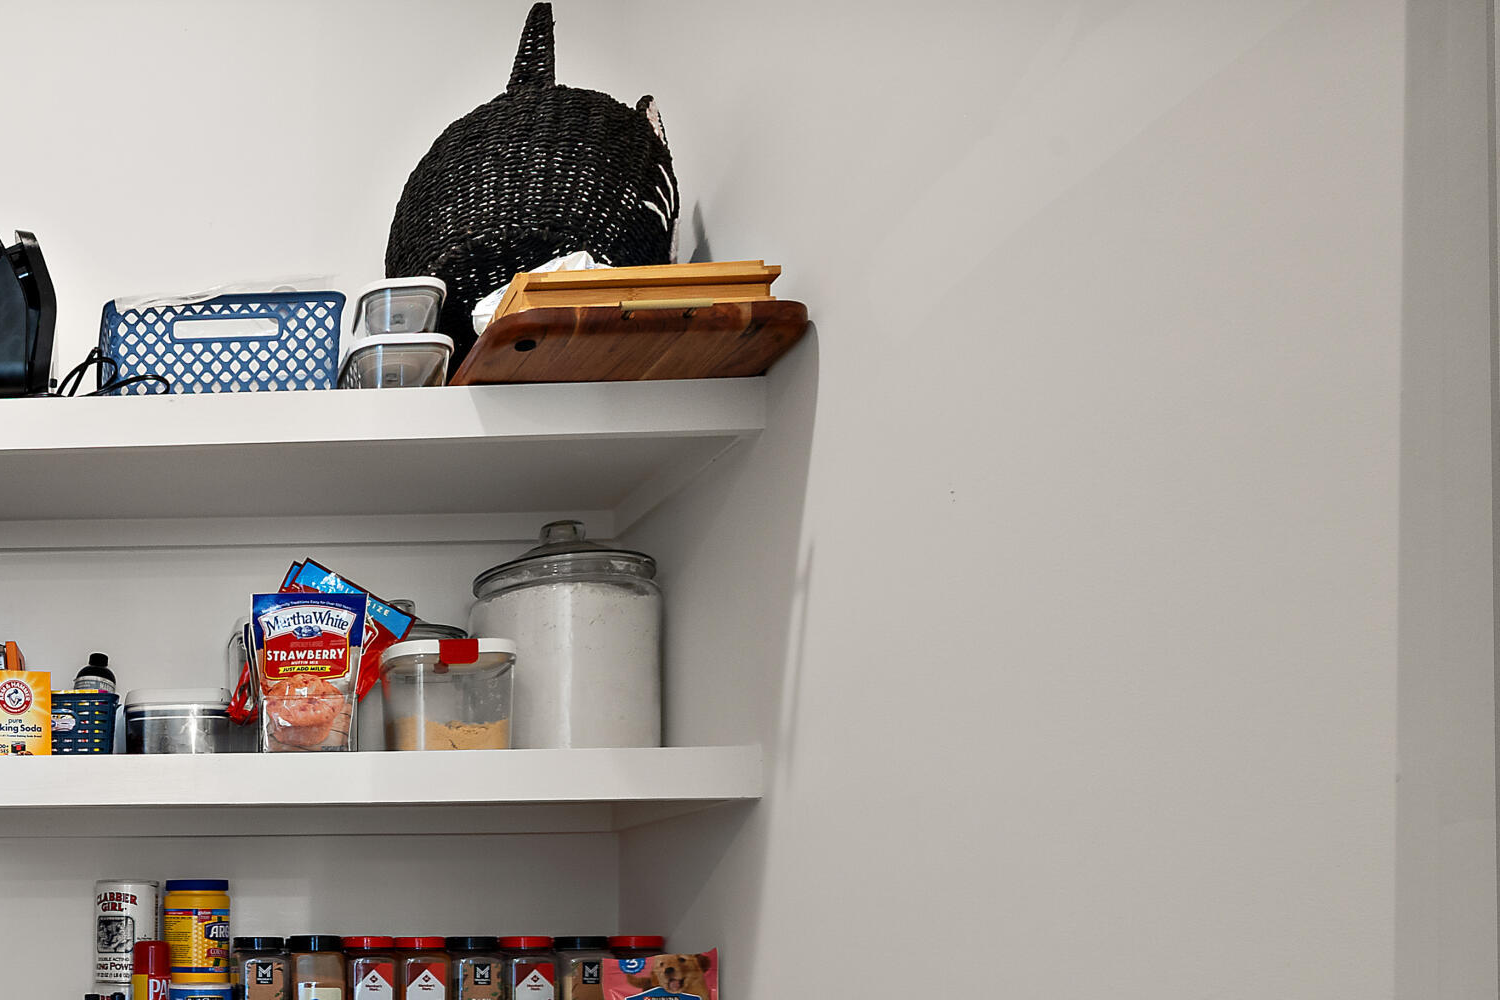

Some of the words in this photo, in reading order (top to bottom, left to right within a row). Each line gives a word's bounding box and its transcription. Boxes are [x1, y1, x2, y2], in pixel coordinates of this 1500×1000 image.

[265, 612, 312, 636] Martha
[312, 610, 349, 631] White
[267, 648, 345, 661] STRAWBERRY
[20, 724, 42, 732] Soda
[101, 902, 124, 912] GIRL
[209, 925, 229, 938] ARG
[109, 962, 134, 971] POWD
[149, 979, 170, 1000] PA
